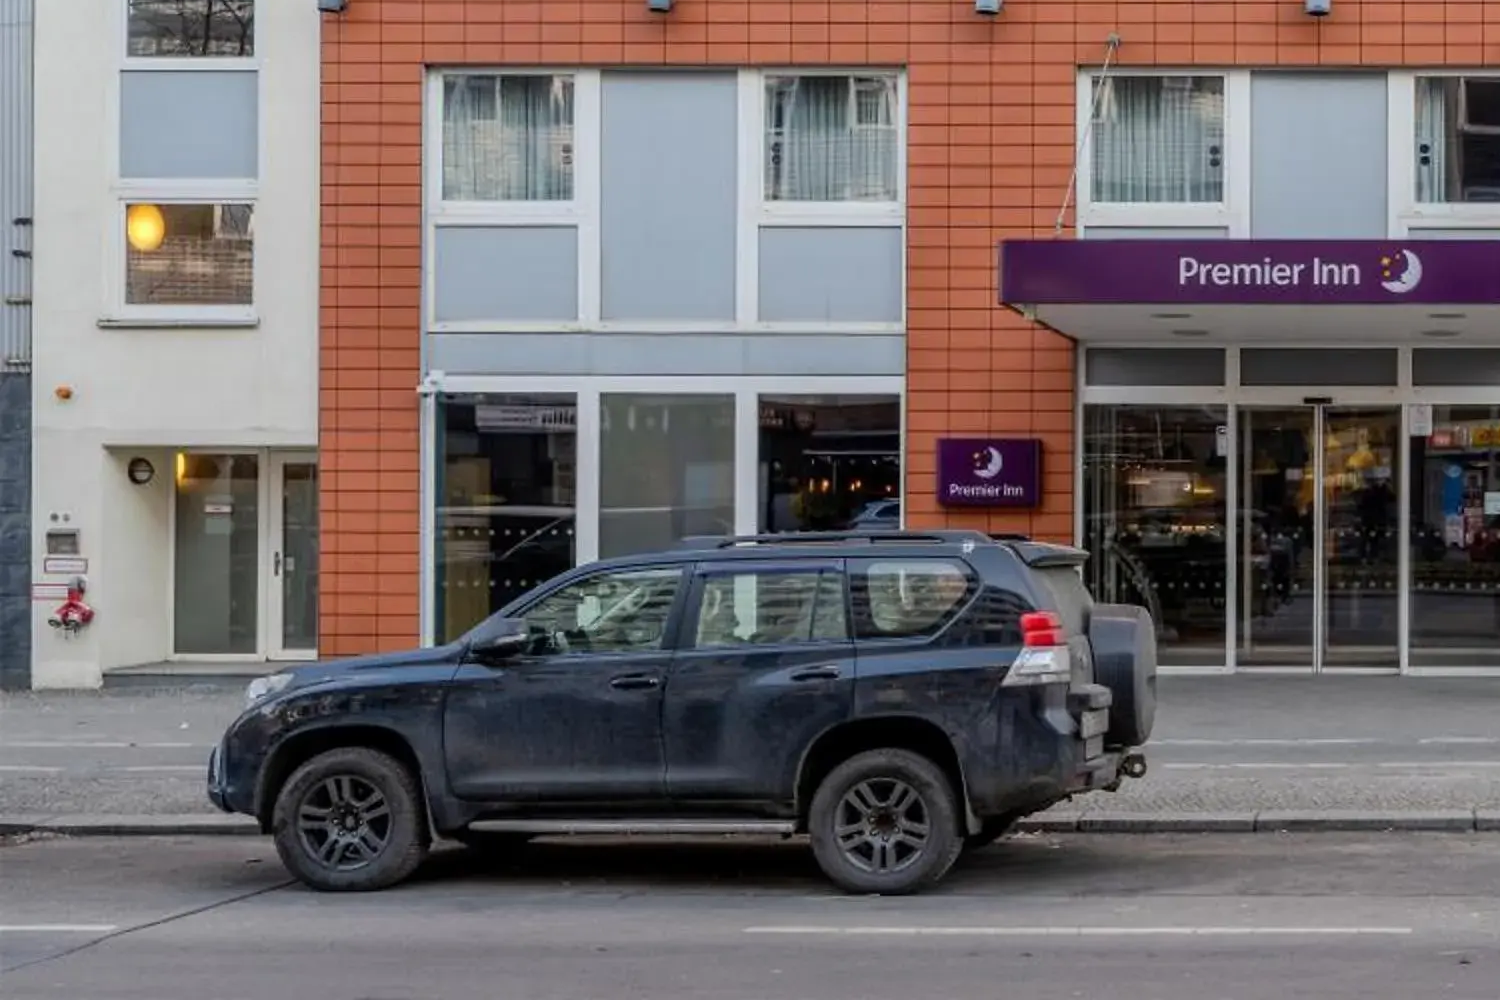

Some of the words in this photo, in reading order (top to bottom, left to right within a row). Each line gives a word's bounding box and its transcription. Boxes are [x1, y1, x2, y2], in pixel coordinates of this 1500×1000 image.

[1179, 257, 1304, 285] Premier
[1313, 257, 1361, 285] Inn
[949, 483, 1001, 497] Premier
[1003, 484, 1024, 497] Inn
